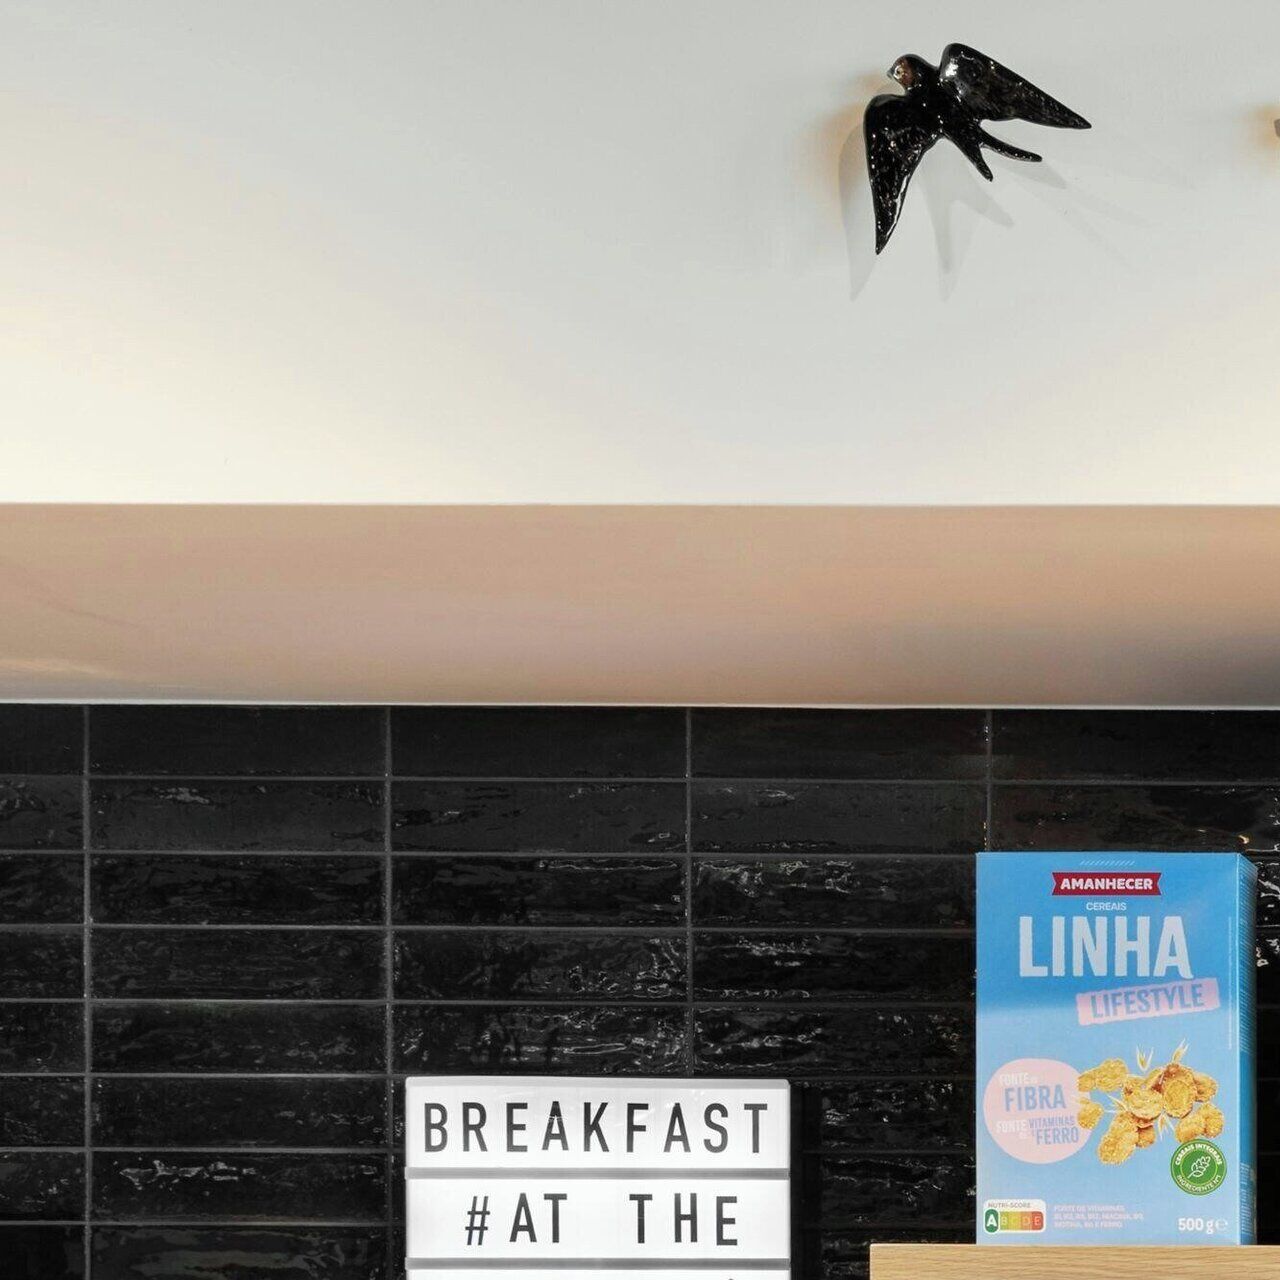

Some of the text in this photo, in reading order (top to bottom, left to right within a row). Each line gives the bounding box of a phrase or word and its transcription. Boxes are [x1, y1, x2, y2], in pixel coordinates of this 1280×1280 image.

[1060, 877, 1153, 890] AMANHECER
[1086, 901, 1127, 911] CEREAIS
[1019, 916, 1194, 978] LINHA
[1090, 982, 1206, 1019] LIFESTYLE
[1004, 1084, 1067, 1112] FIBRA
[424, 1101, 768, 1153] BREAKFAST
[1036, 1126, 1080, 1145] FERRO
[465, 1193, 738, 1246] #AT THE
